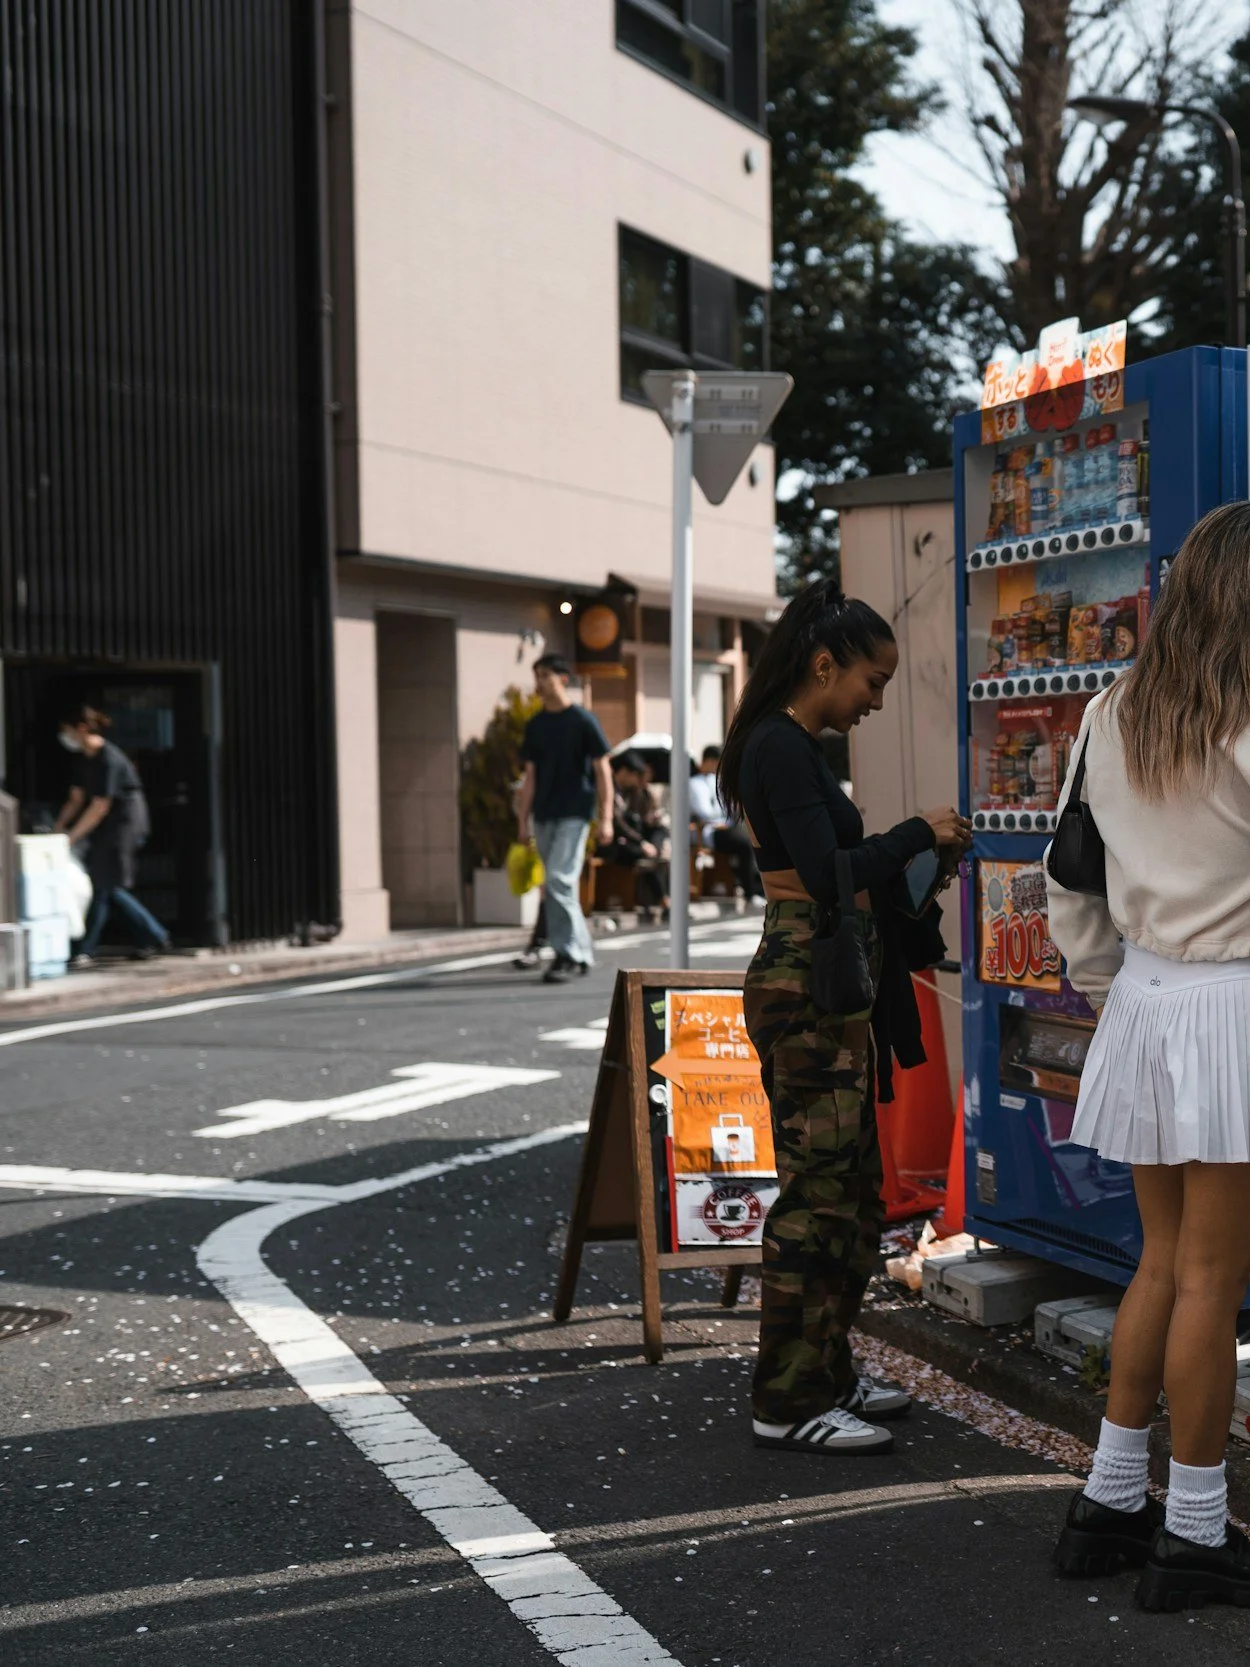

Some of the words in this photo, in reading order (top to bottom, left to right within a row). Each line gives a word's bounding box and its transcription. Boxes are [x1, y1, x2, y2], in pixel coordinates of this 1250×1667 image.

[675, 1011, 747, 1028] スペシャル
[698, 1027, 749, 1044] コーヒ
[705, 1042, 750, 1060] 専門店
[683, 1092, 728, 1107] TAKE
[740, 1092, 765, 1107] OU
[709, 1188, 758, 1207] COFFEE
[720, 1227, 746, 1236] SHOP
